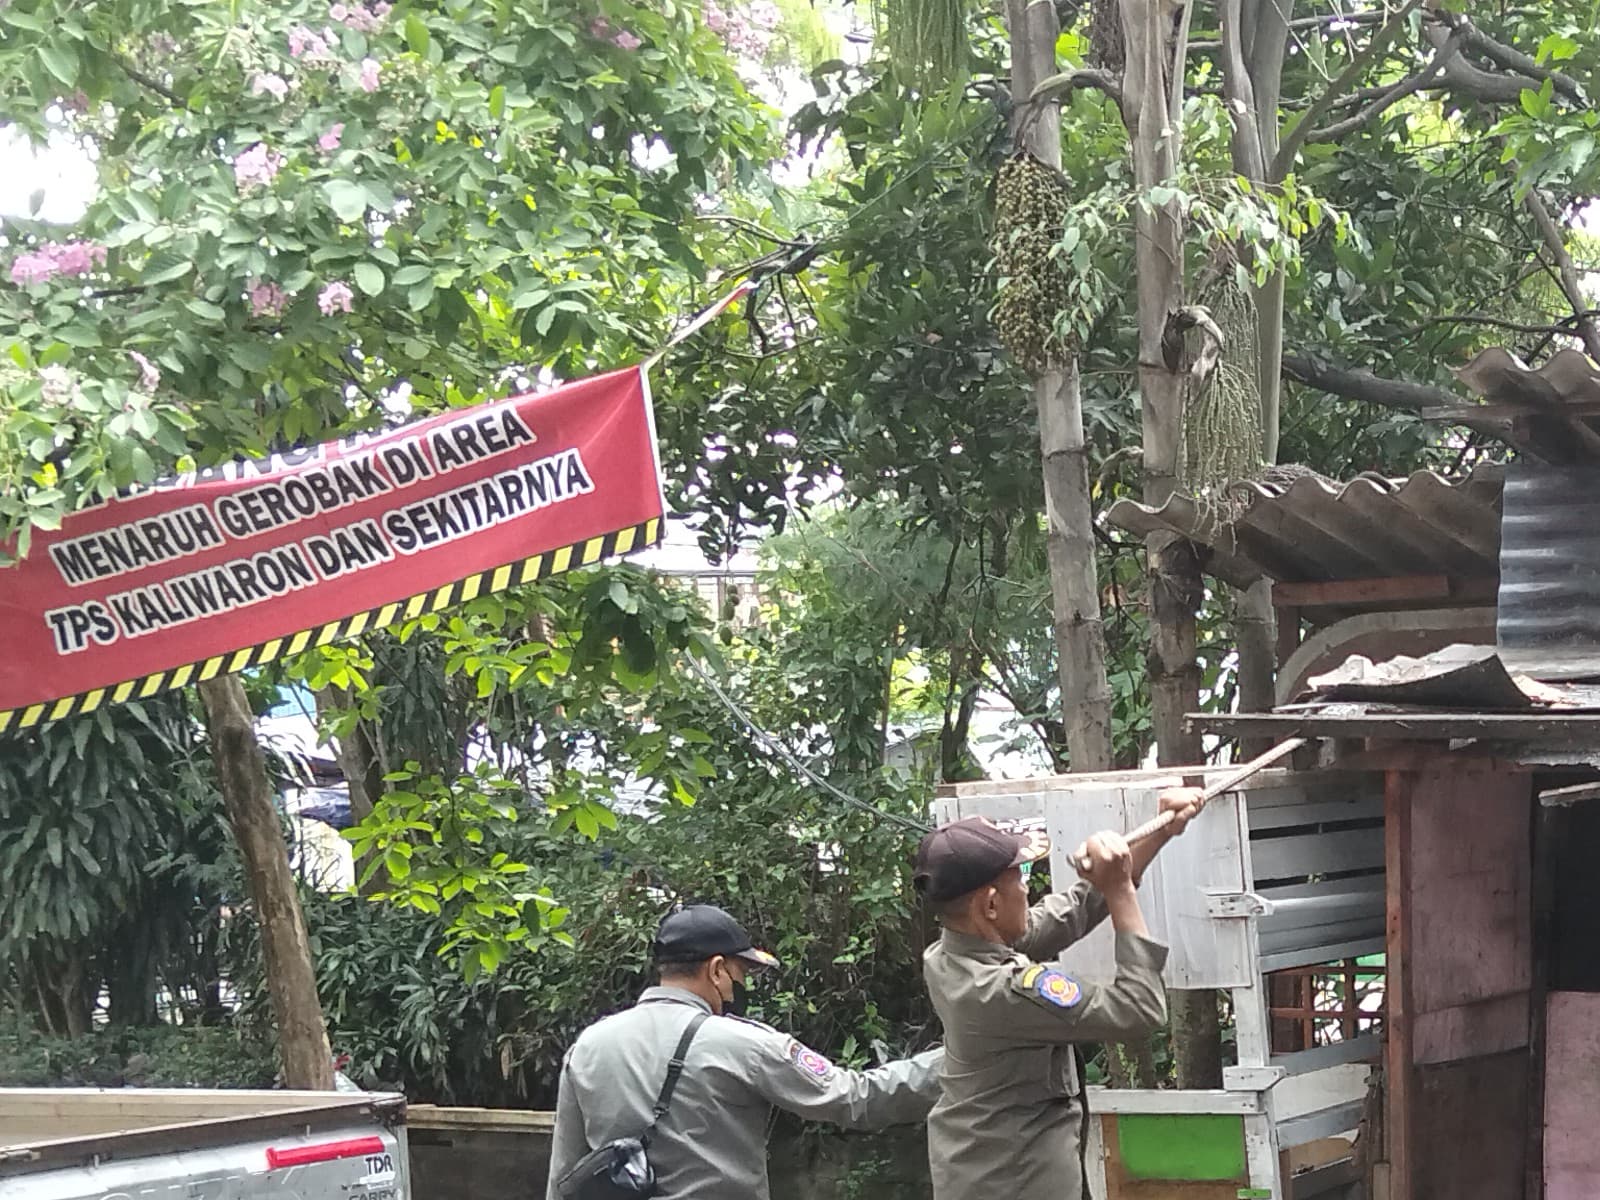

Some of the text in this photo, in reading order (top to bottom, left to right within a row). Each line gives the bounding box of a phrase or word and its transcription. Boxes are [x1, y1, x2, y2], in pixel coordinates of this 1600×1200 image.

[48, 602, 117, 653] TPS
[109, 546, 315, 636] KALIWARON
[307, 521, 391, 576] DAN
[386, 451, 592, 551] SEKITARNYA
[51, 504, 224, 586] MENARUH
[216, 455, 390, 538] GEROBAK
[384, 440, 432, 486] DI
[432, 407, 534, 472] AREA
[364, 1154, 394, 1175] TDR
